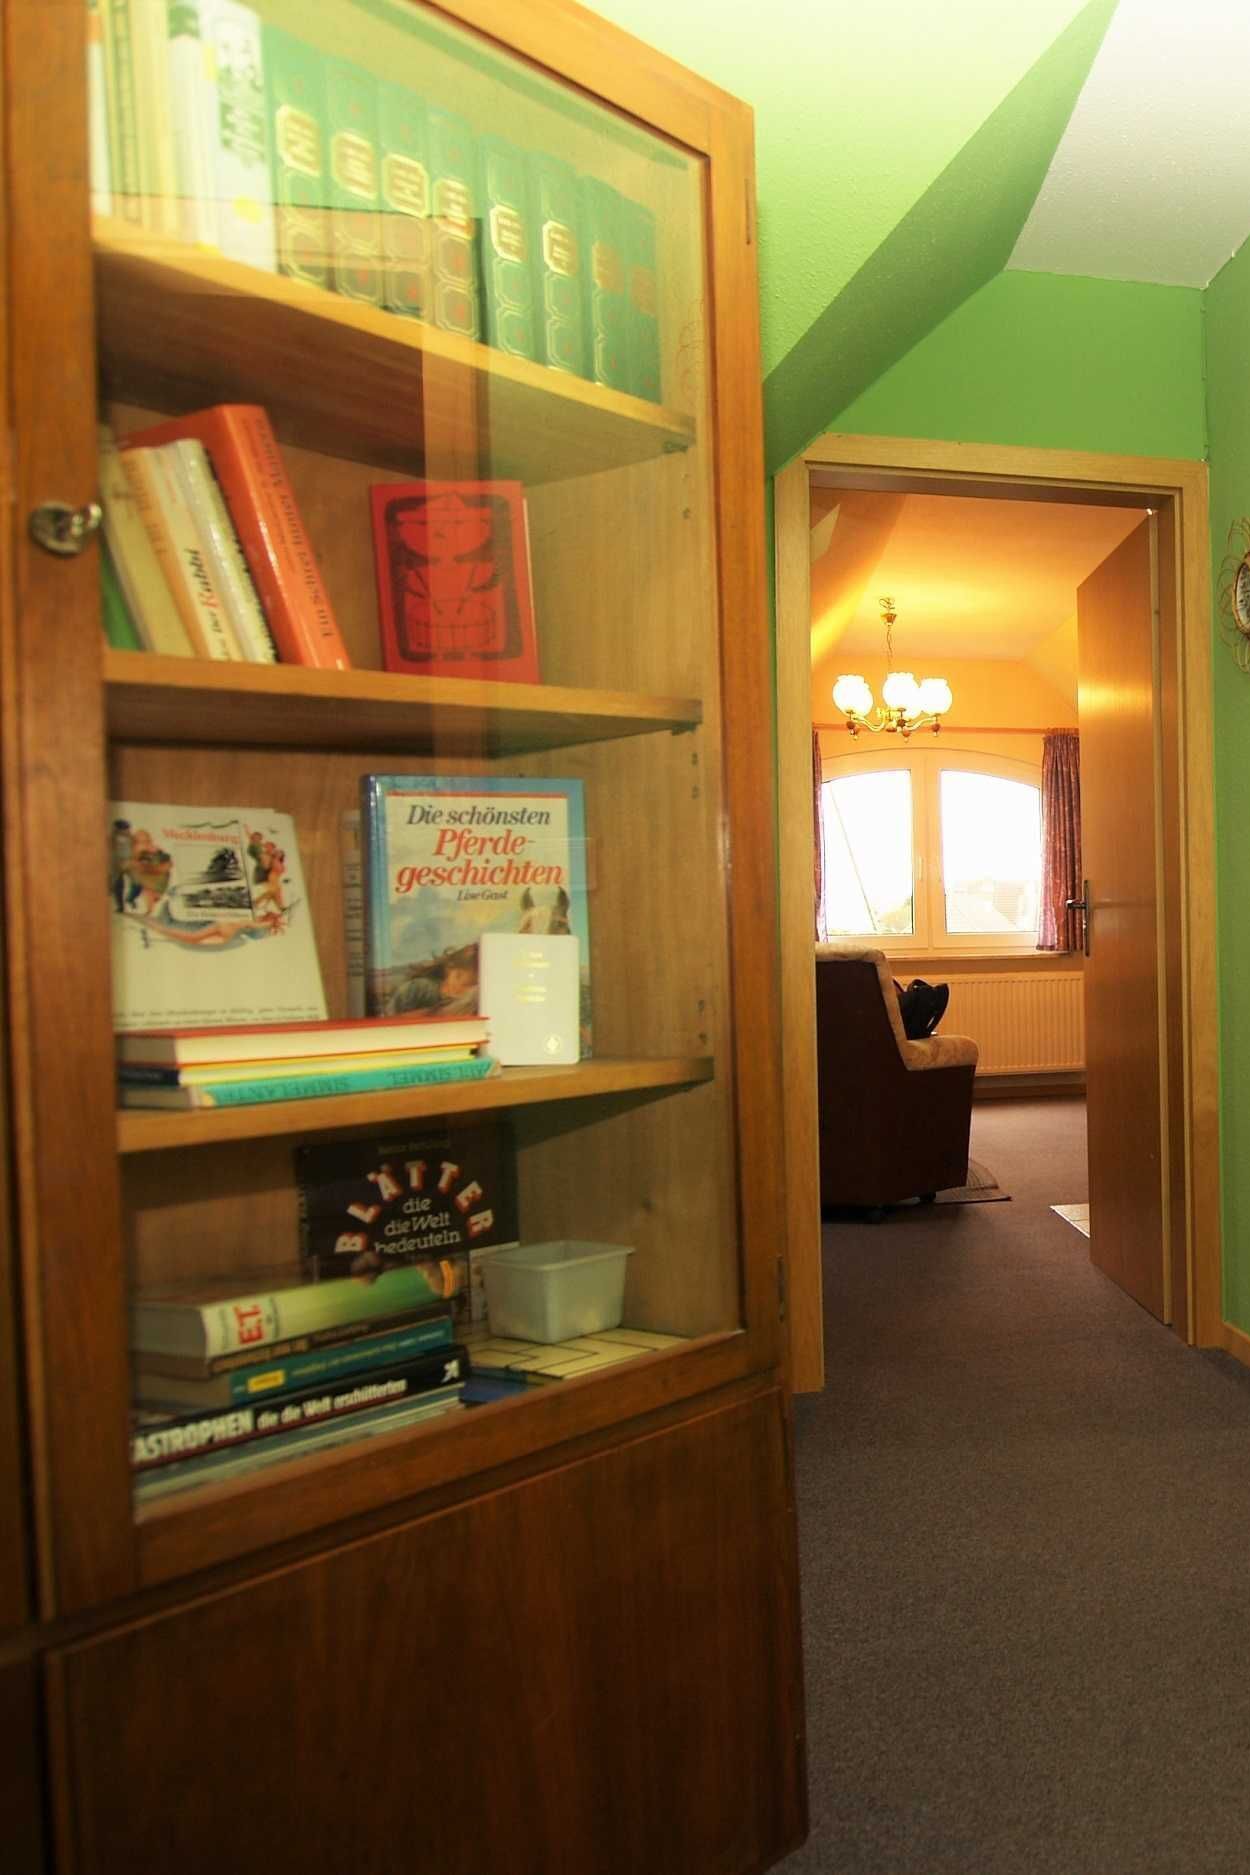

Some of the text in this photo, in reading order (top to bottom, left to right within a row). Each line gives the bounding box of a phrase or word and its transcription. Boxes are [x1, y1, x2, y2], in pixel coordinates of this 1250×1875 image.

[183, 546, 218, 608] Rabbi
[407, 804, 551, 826] Die schönsten
[433, 828, 536, 862] Pferde-
[395, 859, 563, 893] geschichten
[402, 1197, 433, 1214] die
[384, 1212, 450, 1238] die Welt
[303, 1396, 332, 1418] Welt
